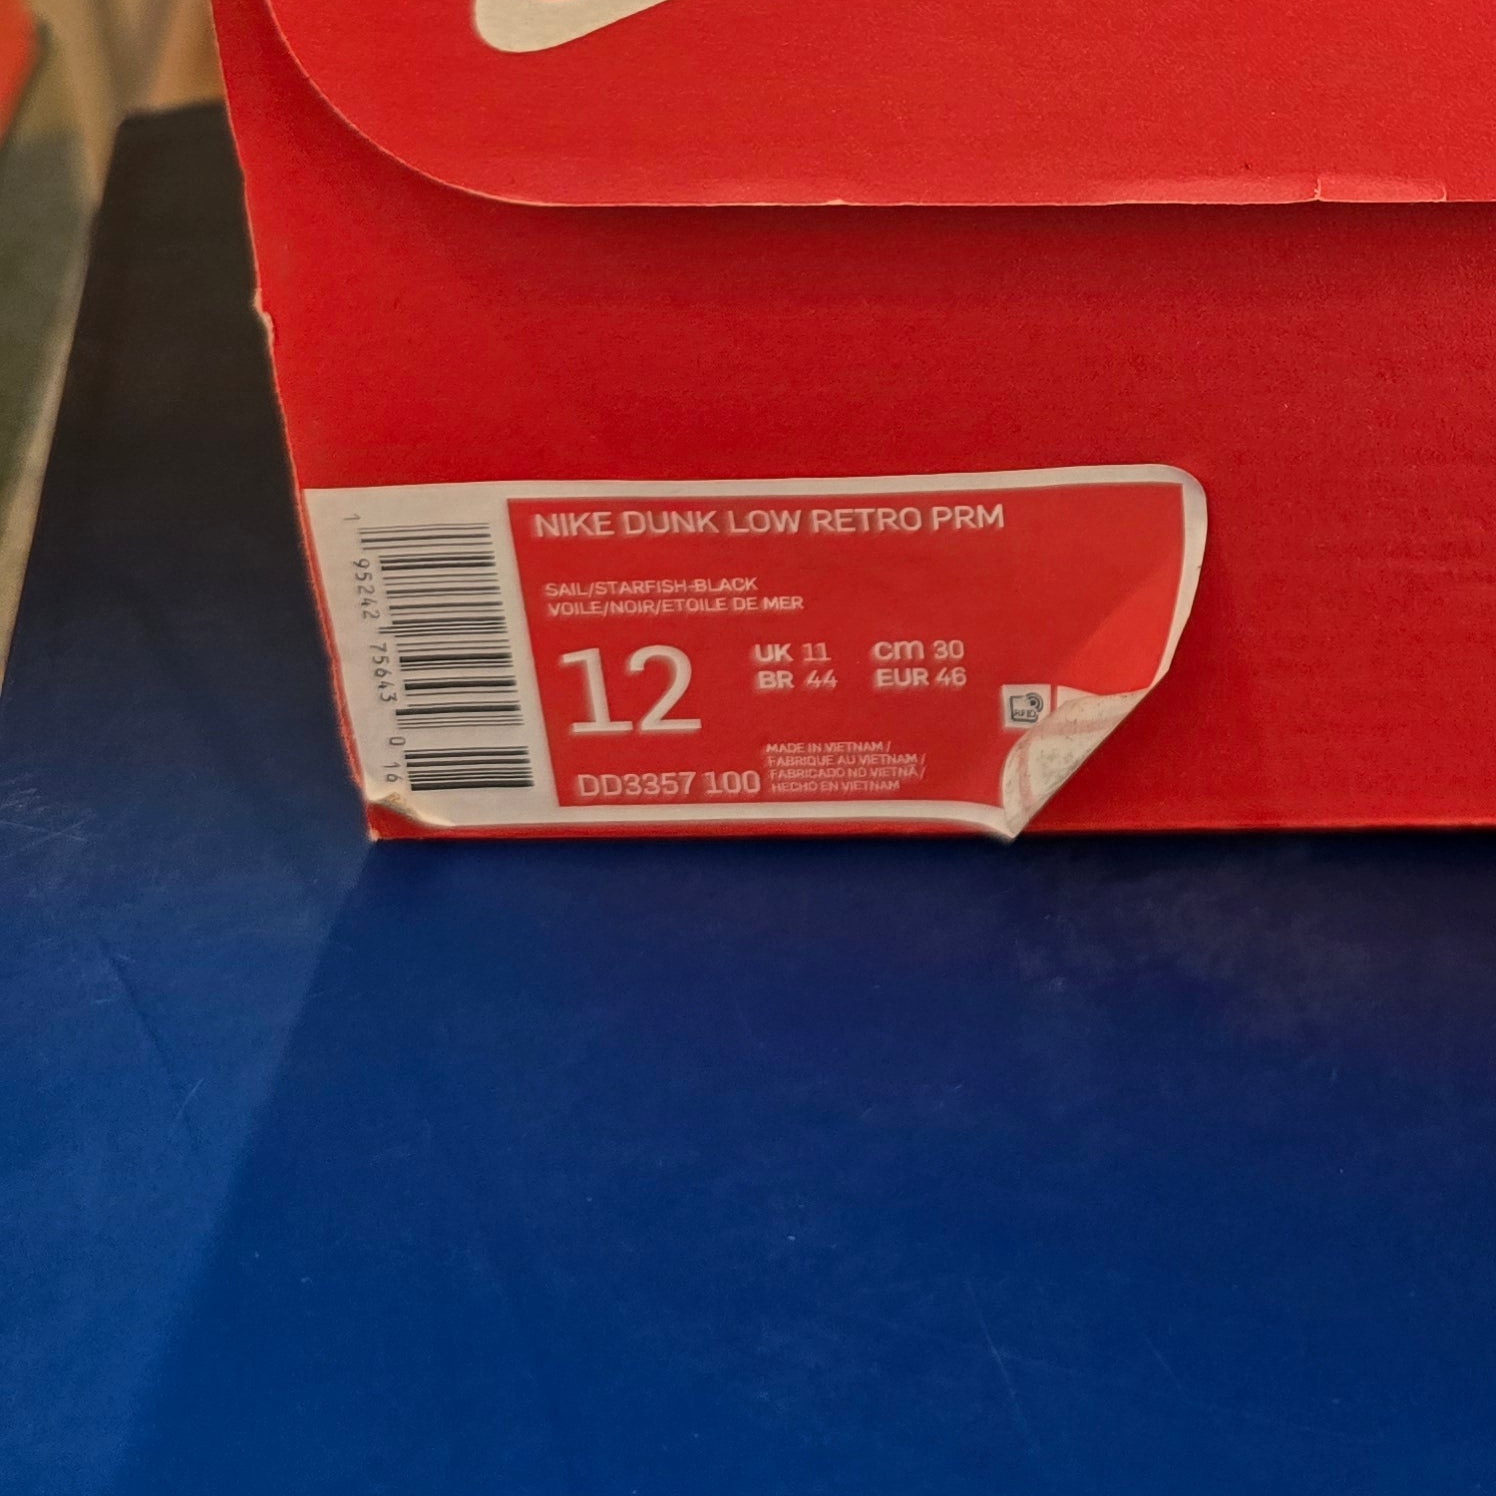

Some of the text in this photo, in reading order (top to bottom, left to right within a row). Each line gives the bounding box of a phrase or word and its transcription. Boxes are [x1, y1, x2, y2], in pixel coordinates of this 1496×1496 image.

[534, 504, 1005, 537] NIKE DUNK LOW RETRO PRM
[545, 577, 758, 597] SAIL/STARFISH-BLACK
[548, 596, 804, 617] VOILE/NOIR/ETOILE DE MER
[352, 557, 380, 620] 95242
[369, 642, 397, 703] 75643
[388, 736, 406, 746] 0
[754, 642, 831, 662] UK 11
[933, 640, 964, 659] 30
[757, 669, 838, 689] BR 44
[875, 667, 967, 687] EUR 46
[559, 644, 702, 733] 12
[766, 742, 804, 753] MADE
[808, 742, 821, 753] IN
[825, 741, 883, 753] VIETNAM
[767, 755, 834, 766] FABRIQUE
[838, 755, 855, 765] AU
[858, 753, 918, 765] VIETNAM
[577, 770, 760, 796] DD3357 100
[769, 768, 845, 779] FABRICADO
[848, 767, 866, 778] NO
[772, 780, 899, 792] HECHO EN VIETNAM
